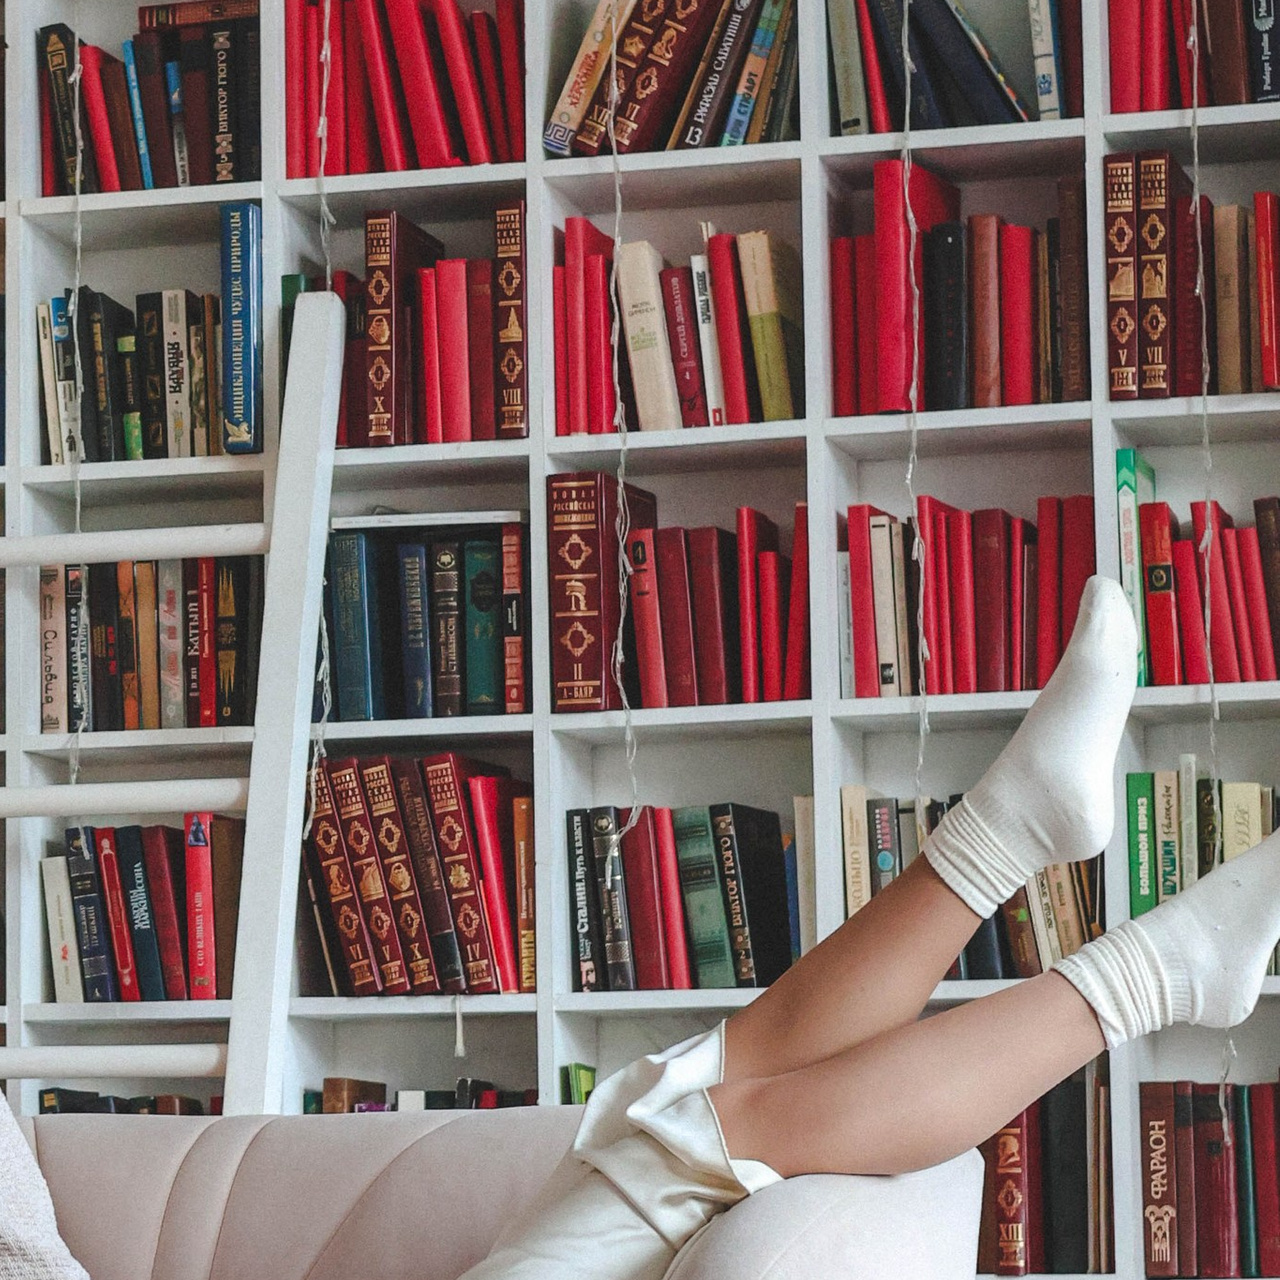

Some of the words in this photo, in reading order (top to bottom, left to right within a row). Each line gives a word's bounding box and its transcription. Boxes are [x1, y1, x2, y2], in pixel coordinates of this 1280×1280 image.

[217, 49, 227, 84] ГЮГО
[693, 70, 721, 123] РАФАЭЛЬ
[711, 11, 742, 72] САБАТИНИ
[217, 87, 228, 131] ВИКТОР
[735, 69, 759, 116] СТЮАРТ
[230, 209, 242, 272] ПРИРОДЫ
[230, 276, 243, 315] ЧУДЕС
[231, 319, 244, 421] ЭНЦИКЛОПЕДИЯ
[1146, 345, 1163, 363] VII
[502, 388, 522, 405] VIII
[553, 489, 594, 500] НОВАЯ
[553, 500, 594, 512] РОССИЙСКАЯ
[186, 602, 199, 656] БАТЫЙ
[445, 615, 458, 673] СТИВЕНСОН
[573, 663, 582, 680] II
[1137, 797, 1148, 830] ПРИЗ
[718, 835, 736, 875] ГЮГО
[1138, 833, 1149, 895] БОЛЬШОЙ
[129, 887, 143, 929] ЗАКОНЫ
[133, 860, 150, 929] ПАРКИНСОНА
[724, 876, 744, 926] ВИКТОР
[409, 942, 422, 959] X
[465, 942, 480, 960] IV
[1149, 1119, 1168, 1198] ФАРАОН
